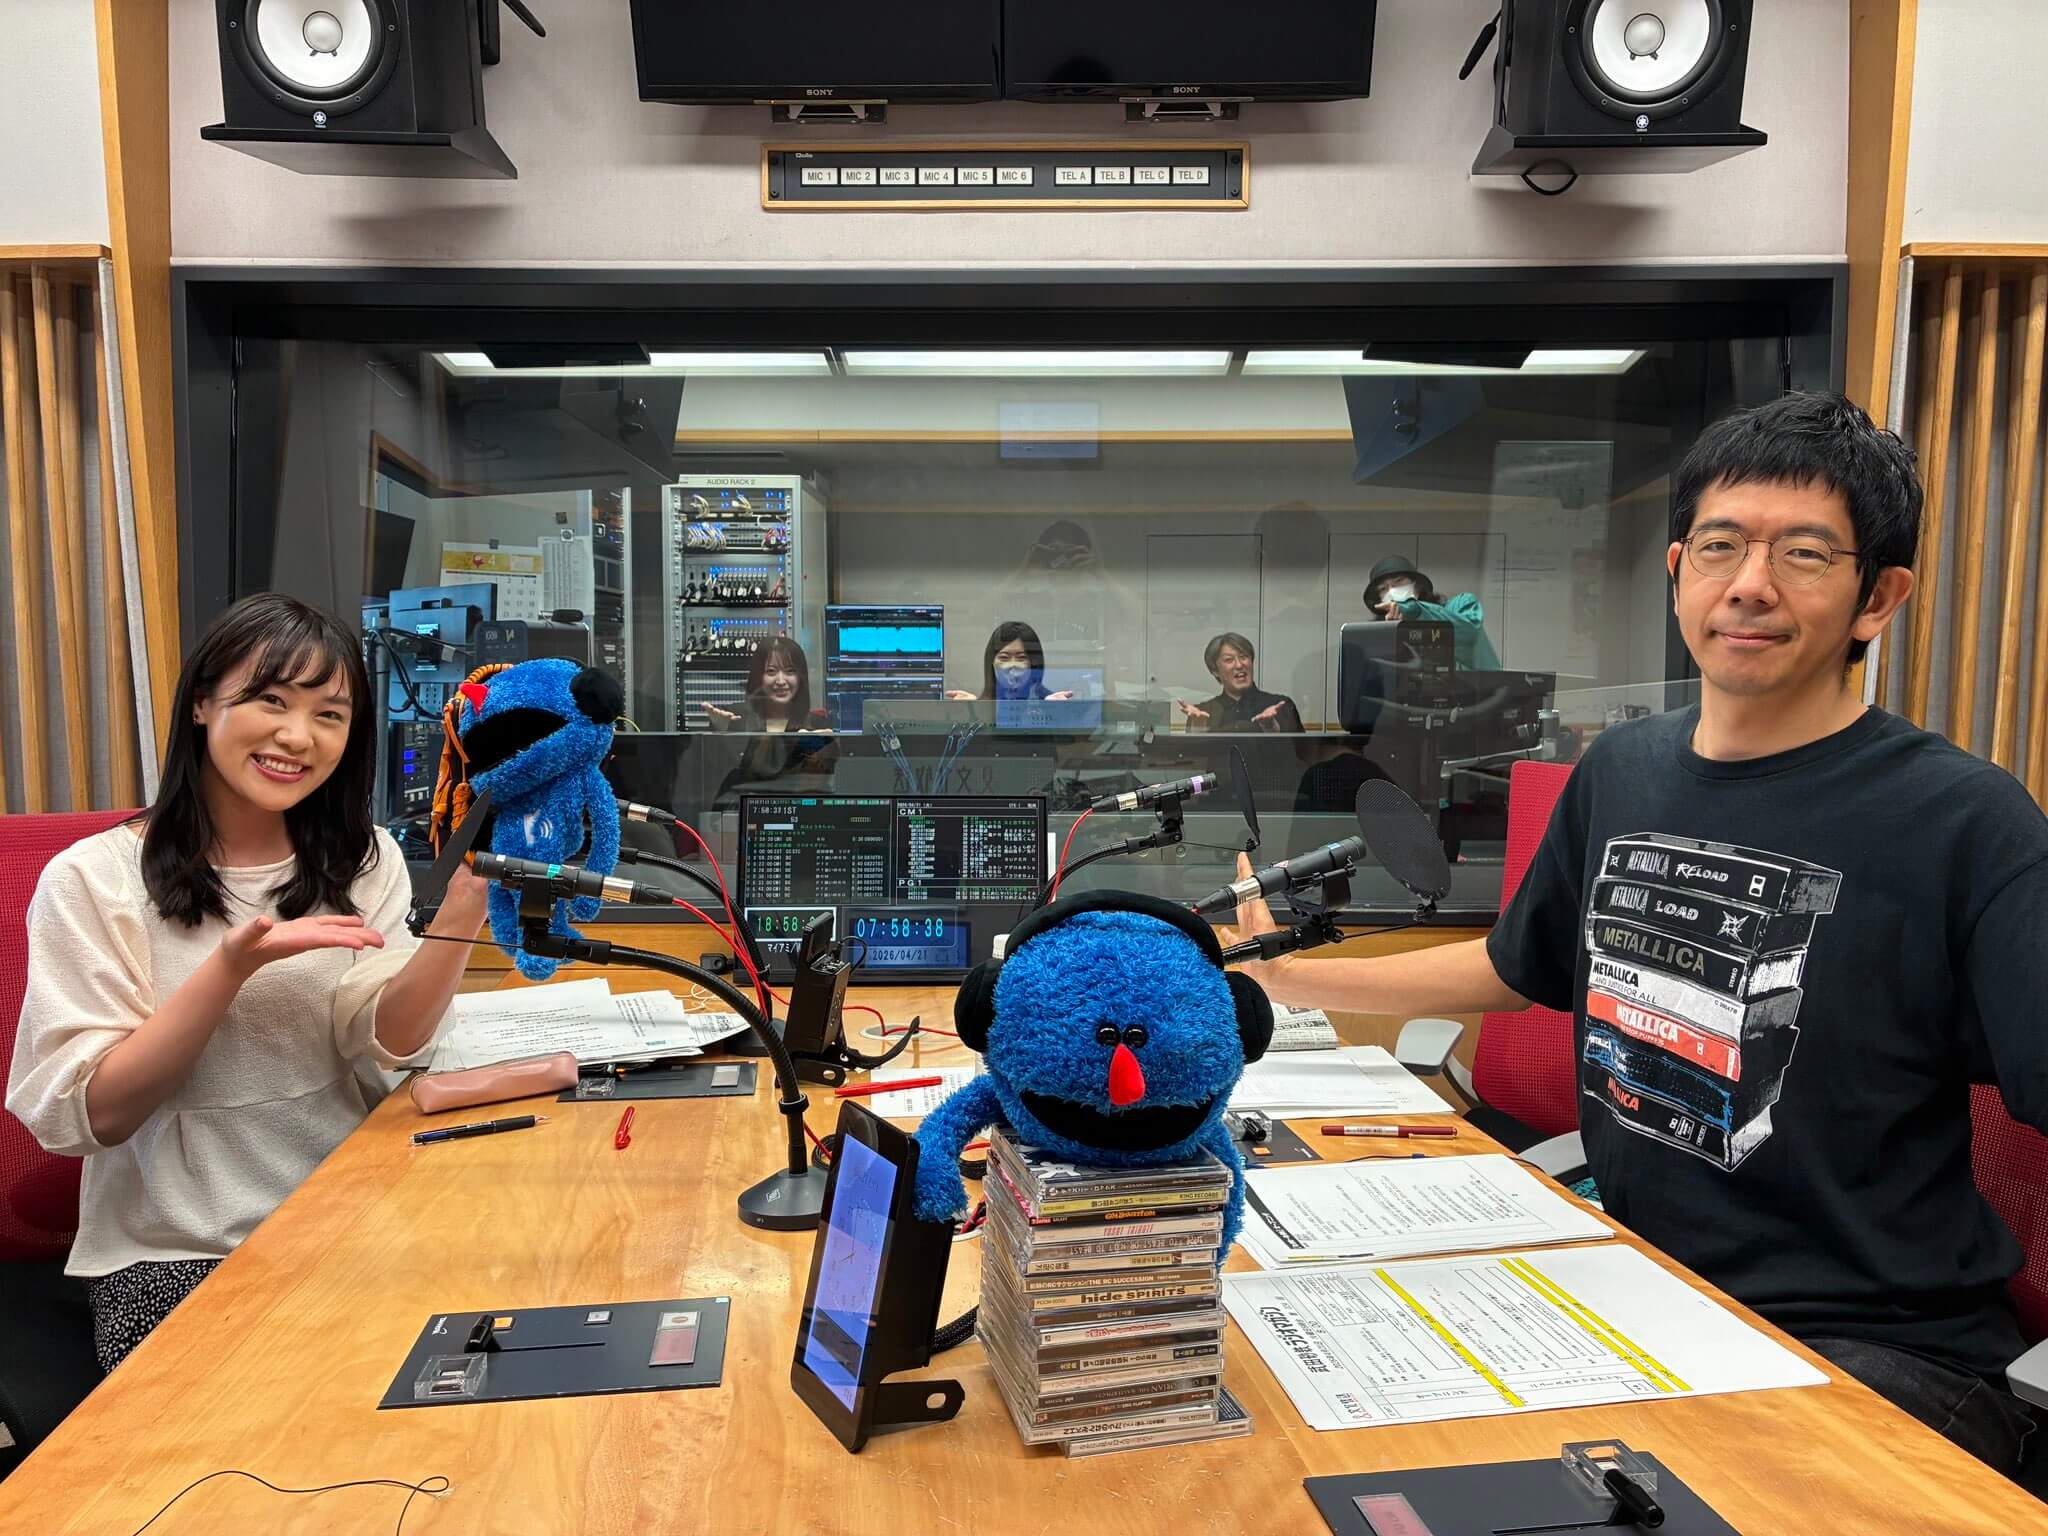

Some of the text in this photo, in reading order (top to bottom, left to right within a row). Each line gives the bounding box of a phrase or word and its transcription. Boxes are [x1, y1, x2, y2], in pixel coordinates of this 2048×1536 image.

[807, 171, 832, 181] MIC 1
[846, 171, 871, 181] MIC 2
[885, 171, 910, 181] MIC 3
[924, 171, 948, 181] MIC 4
[962, 171, 988, 181] MIC 5
[1002, 171, 1027, 181] MIC 6
[1061, 171, 1086, 180] TEL A
[1101, 171, 1125, 180] TEL B
[1140, 171, 1165, 180] TEL C
[1179, 171, 1203, 180] TEL D
[1675, 862, 1729, 882] RELOAD
[1654, 900, 1699, 921] LOAD
[857, 917, 944, 937] 07:58:38
[872, 950, 927, 961] 2026/04/21
[1603, 926, 1705, 977] METALLICA
[1592, 960, 1639, 987] METALLICA
[1638, 992, 1657, 1004] ALL
[1080, 1291, 1122, 1303] hide
[1126, 1285, 1185, 1300] SPIRITS
